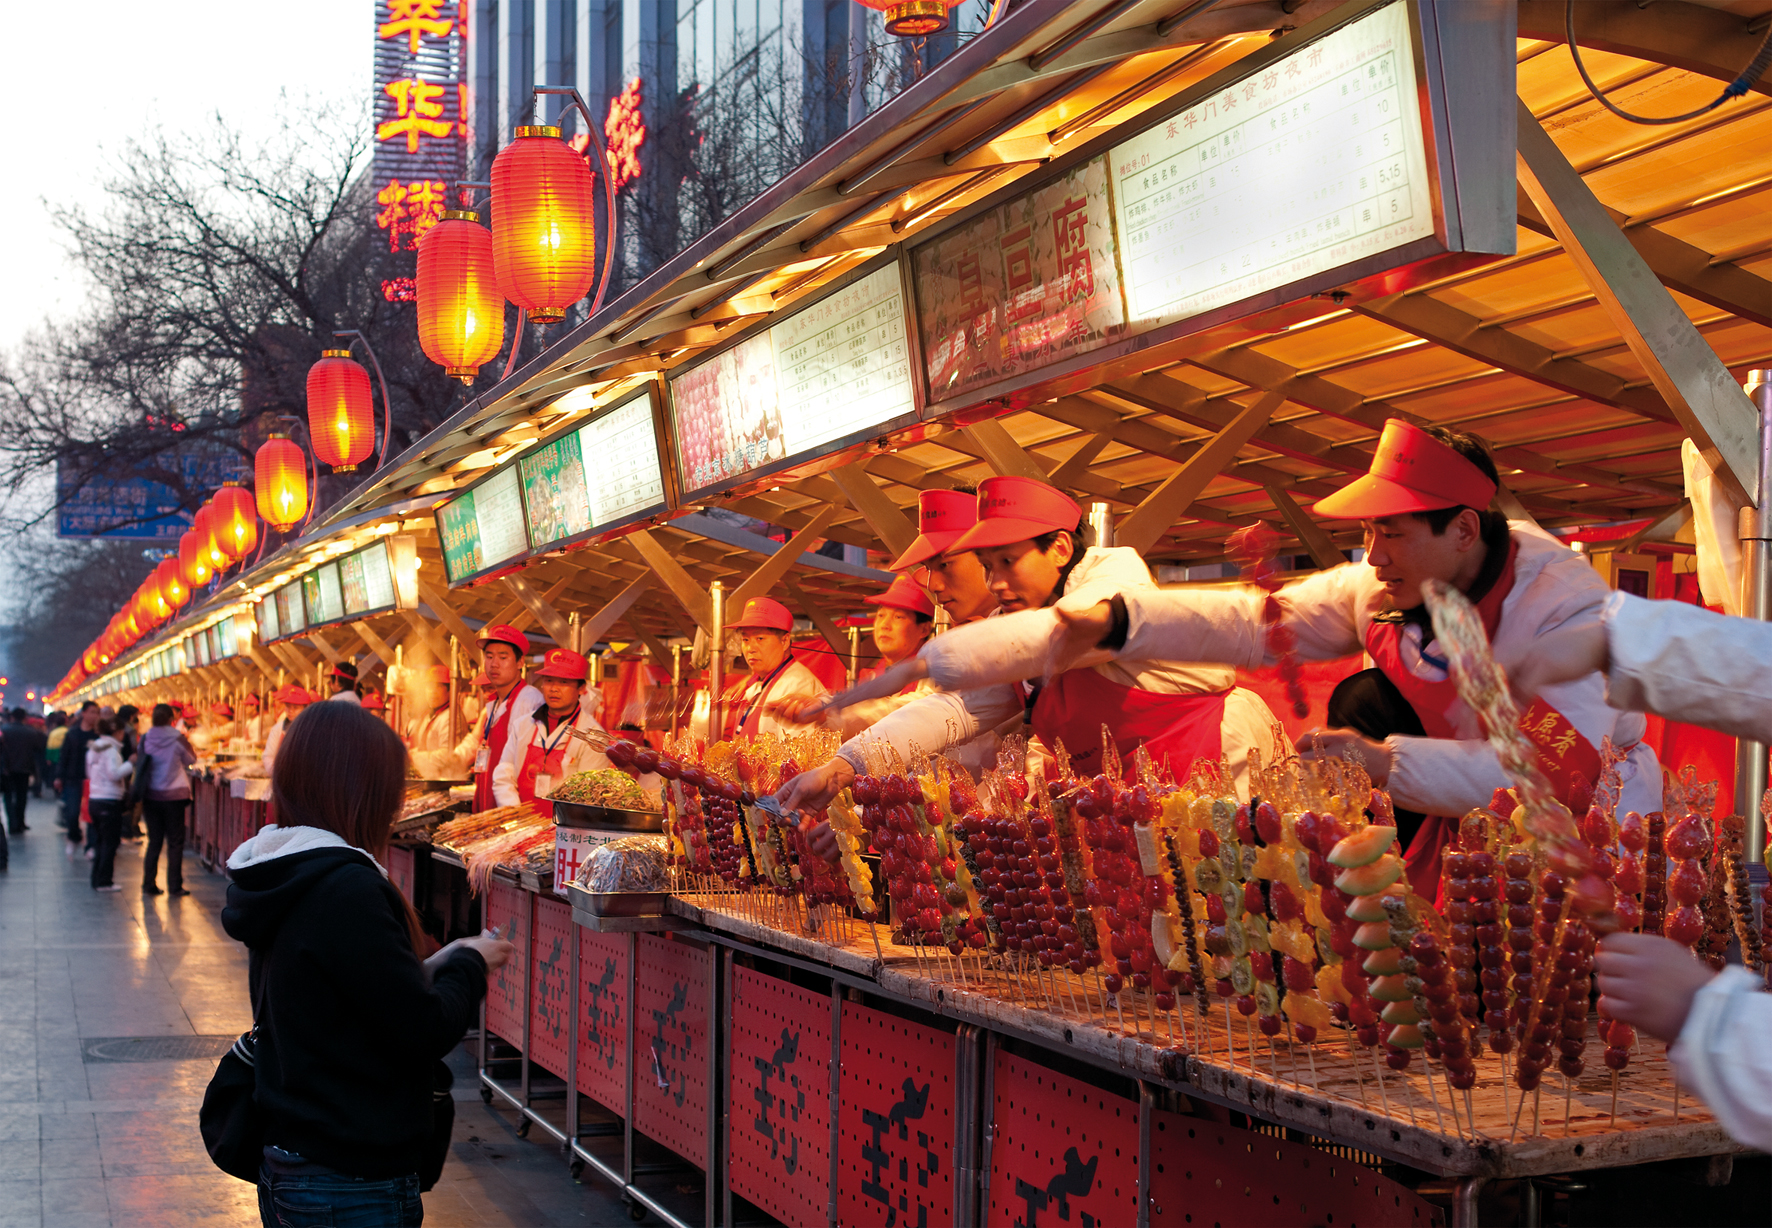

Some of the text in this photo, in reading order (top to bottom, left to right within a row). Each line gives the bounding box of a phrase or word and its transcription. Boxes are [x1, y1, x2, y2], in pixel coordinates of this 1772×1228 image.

[1165, 47, 1323, 140] 东华门美食坊夜市
[1377, 99, 1388, 113] 10
[1143, 59, 1389, 190] 食品名称 单位 单价 食品名称 单位 单价
[1383, 133, 1389, 147] 5
[1363, 209, 1371, 222] 串
[1391, 199, 1398, 213] 5
[799, 283, 869, 330] 东华门美食坊夜市
[894, 324, 897, 334] 5
[694, 438, 769, 483] 老北京冰糖葫芦
[556, 831, 616, 846] 秘制老北
